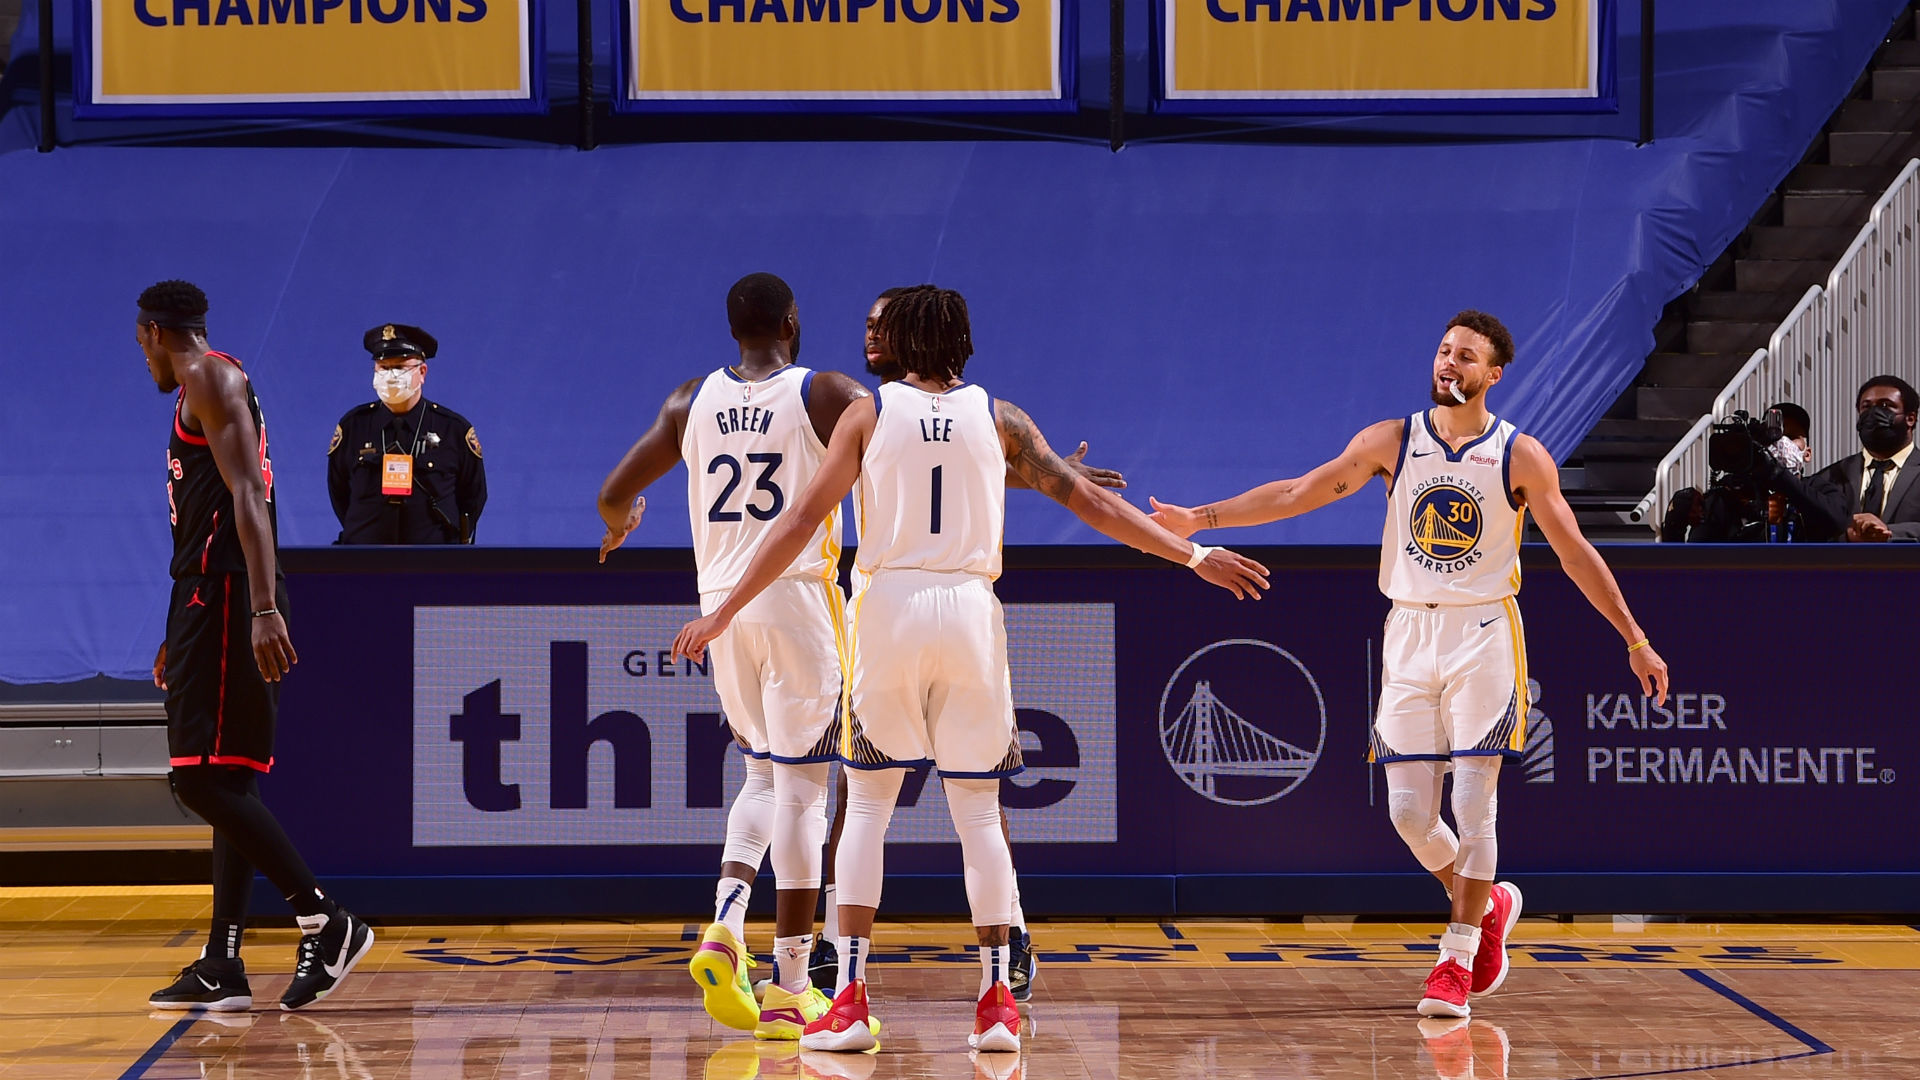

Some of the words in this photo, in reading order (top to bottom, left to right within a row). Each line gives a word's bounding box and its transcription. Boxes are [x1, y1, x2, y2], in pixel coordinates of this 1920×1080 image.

[133, 0, 489, 27] CHAMPIONS
[716, 406, 774, 435] GREEN
[919, 417, 953, 443] LEE
[1469, 453, 1500, 468] Rakuten
[707, 453, 785, 523] 23
[930, 464, 943, 535] 1
[1411, 475, 1454, 497] GOLDEN
[1457, 478, 1486, 504] STATE
[1447, 501, 1474, 523] 30
[1404, 541, 1483, 574] WARRIORS
[449, 640, 1082, 813] thre
[1586, 693, 1727, 731] KAISER
